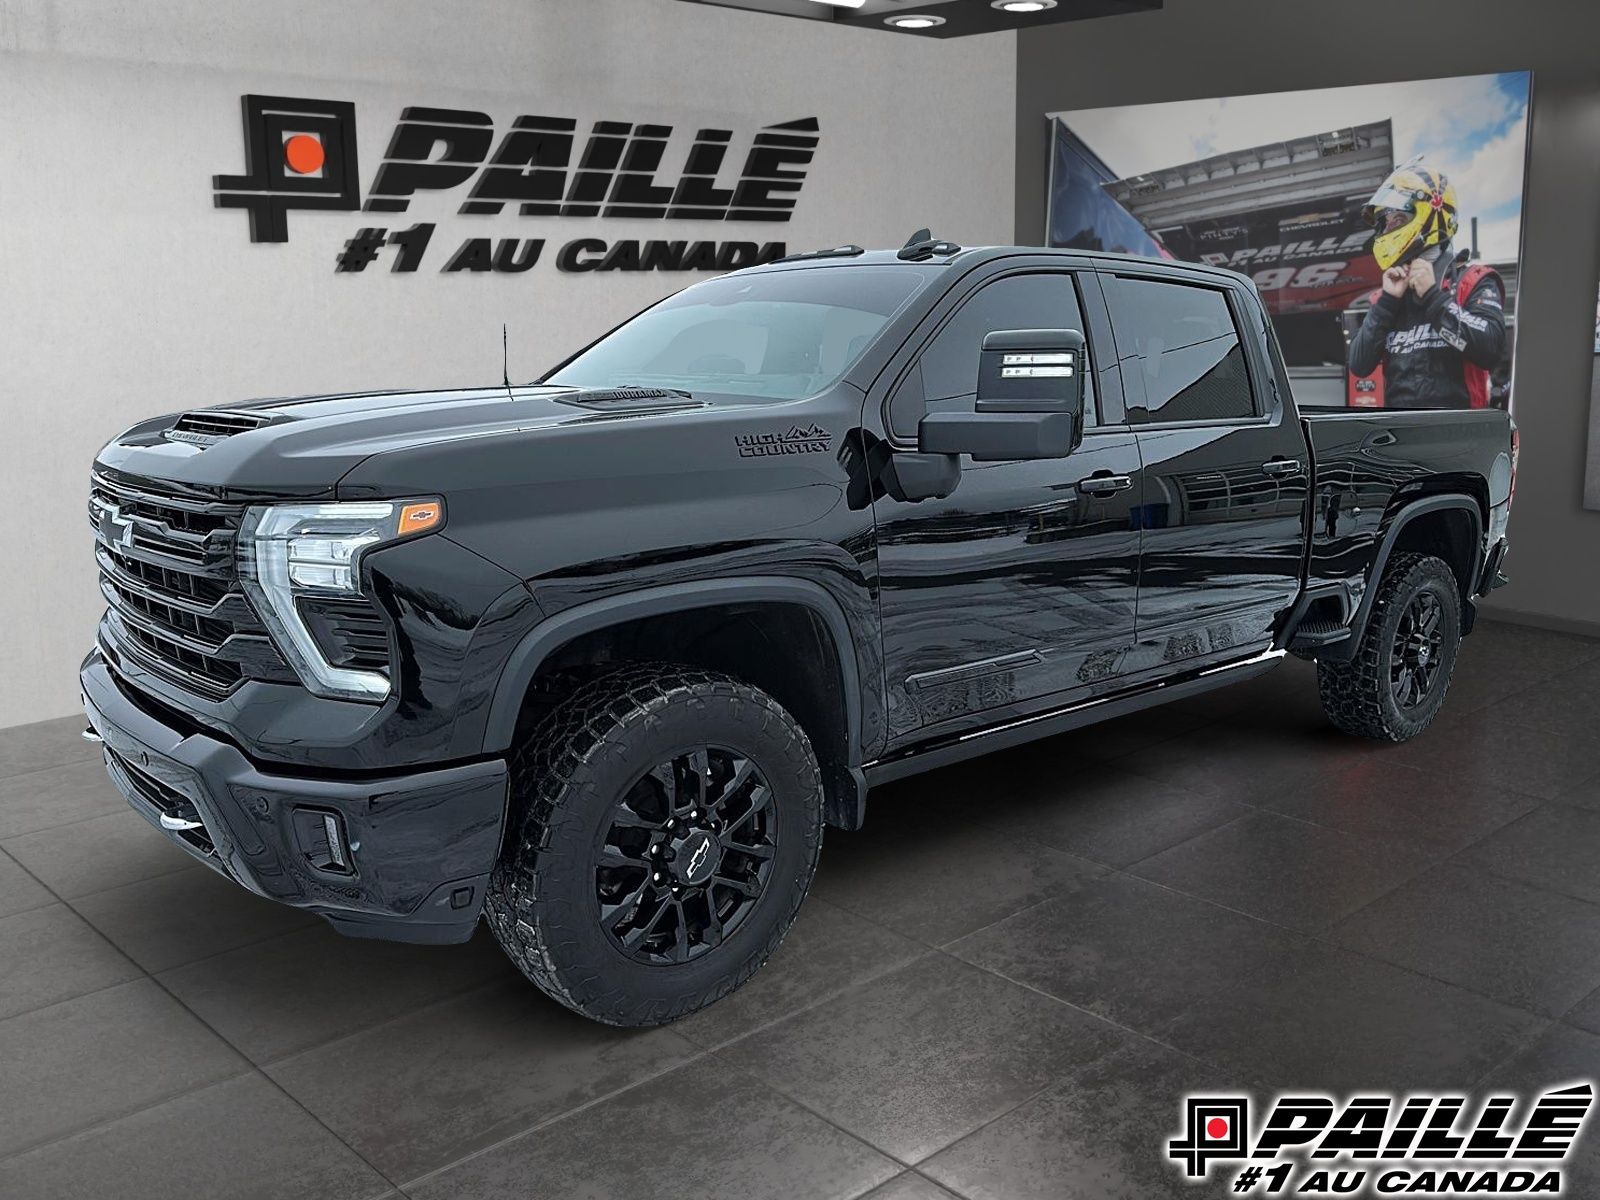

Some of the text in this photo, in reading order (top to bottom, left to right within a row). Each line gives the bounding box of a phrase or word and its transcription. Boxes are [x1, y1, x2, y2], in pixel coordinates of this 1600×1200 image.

[362, 106, 819, 222] PAILLÉ
[1279, 218, 1345, 233] CHEVROLET
[335, 223, 787, 274] #1 AU CANADA
[1252, 256, 1278, 264] AU
[1284, 246, 1364, 261] CANADA
[1252, 261, 1348, 292] 96
[734, 433, 784, 447] HIGH
[739, 440, 831, 458] COUNTRY
